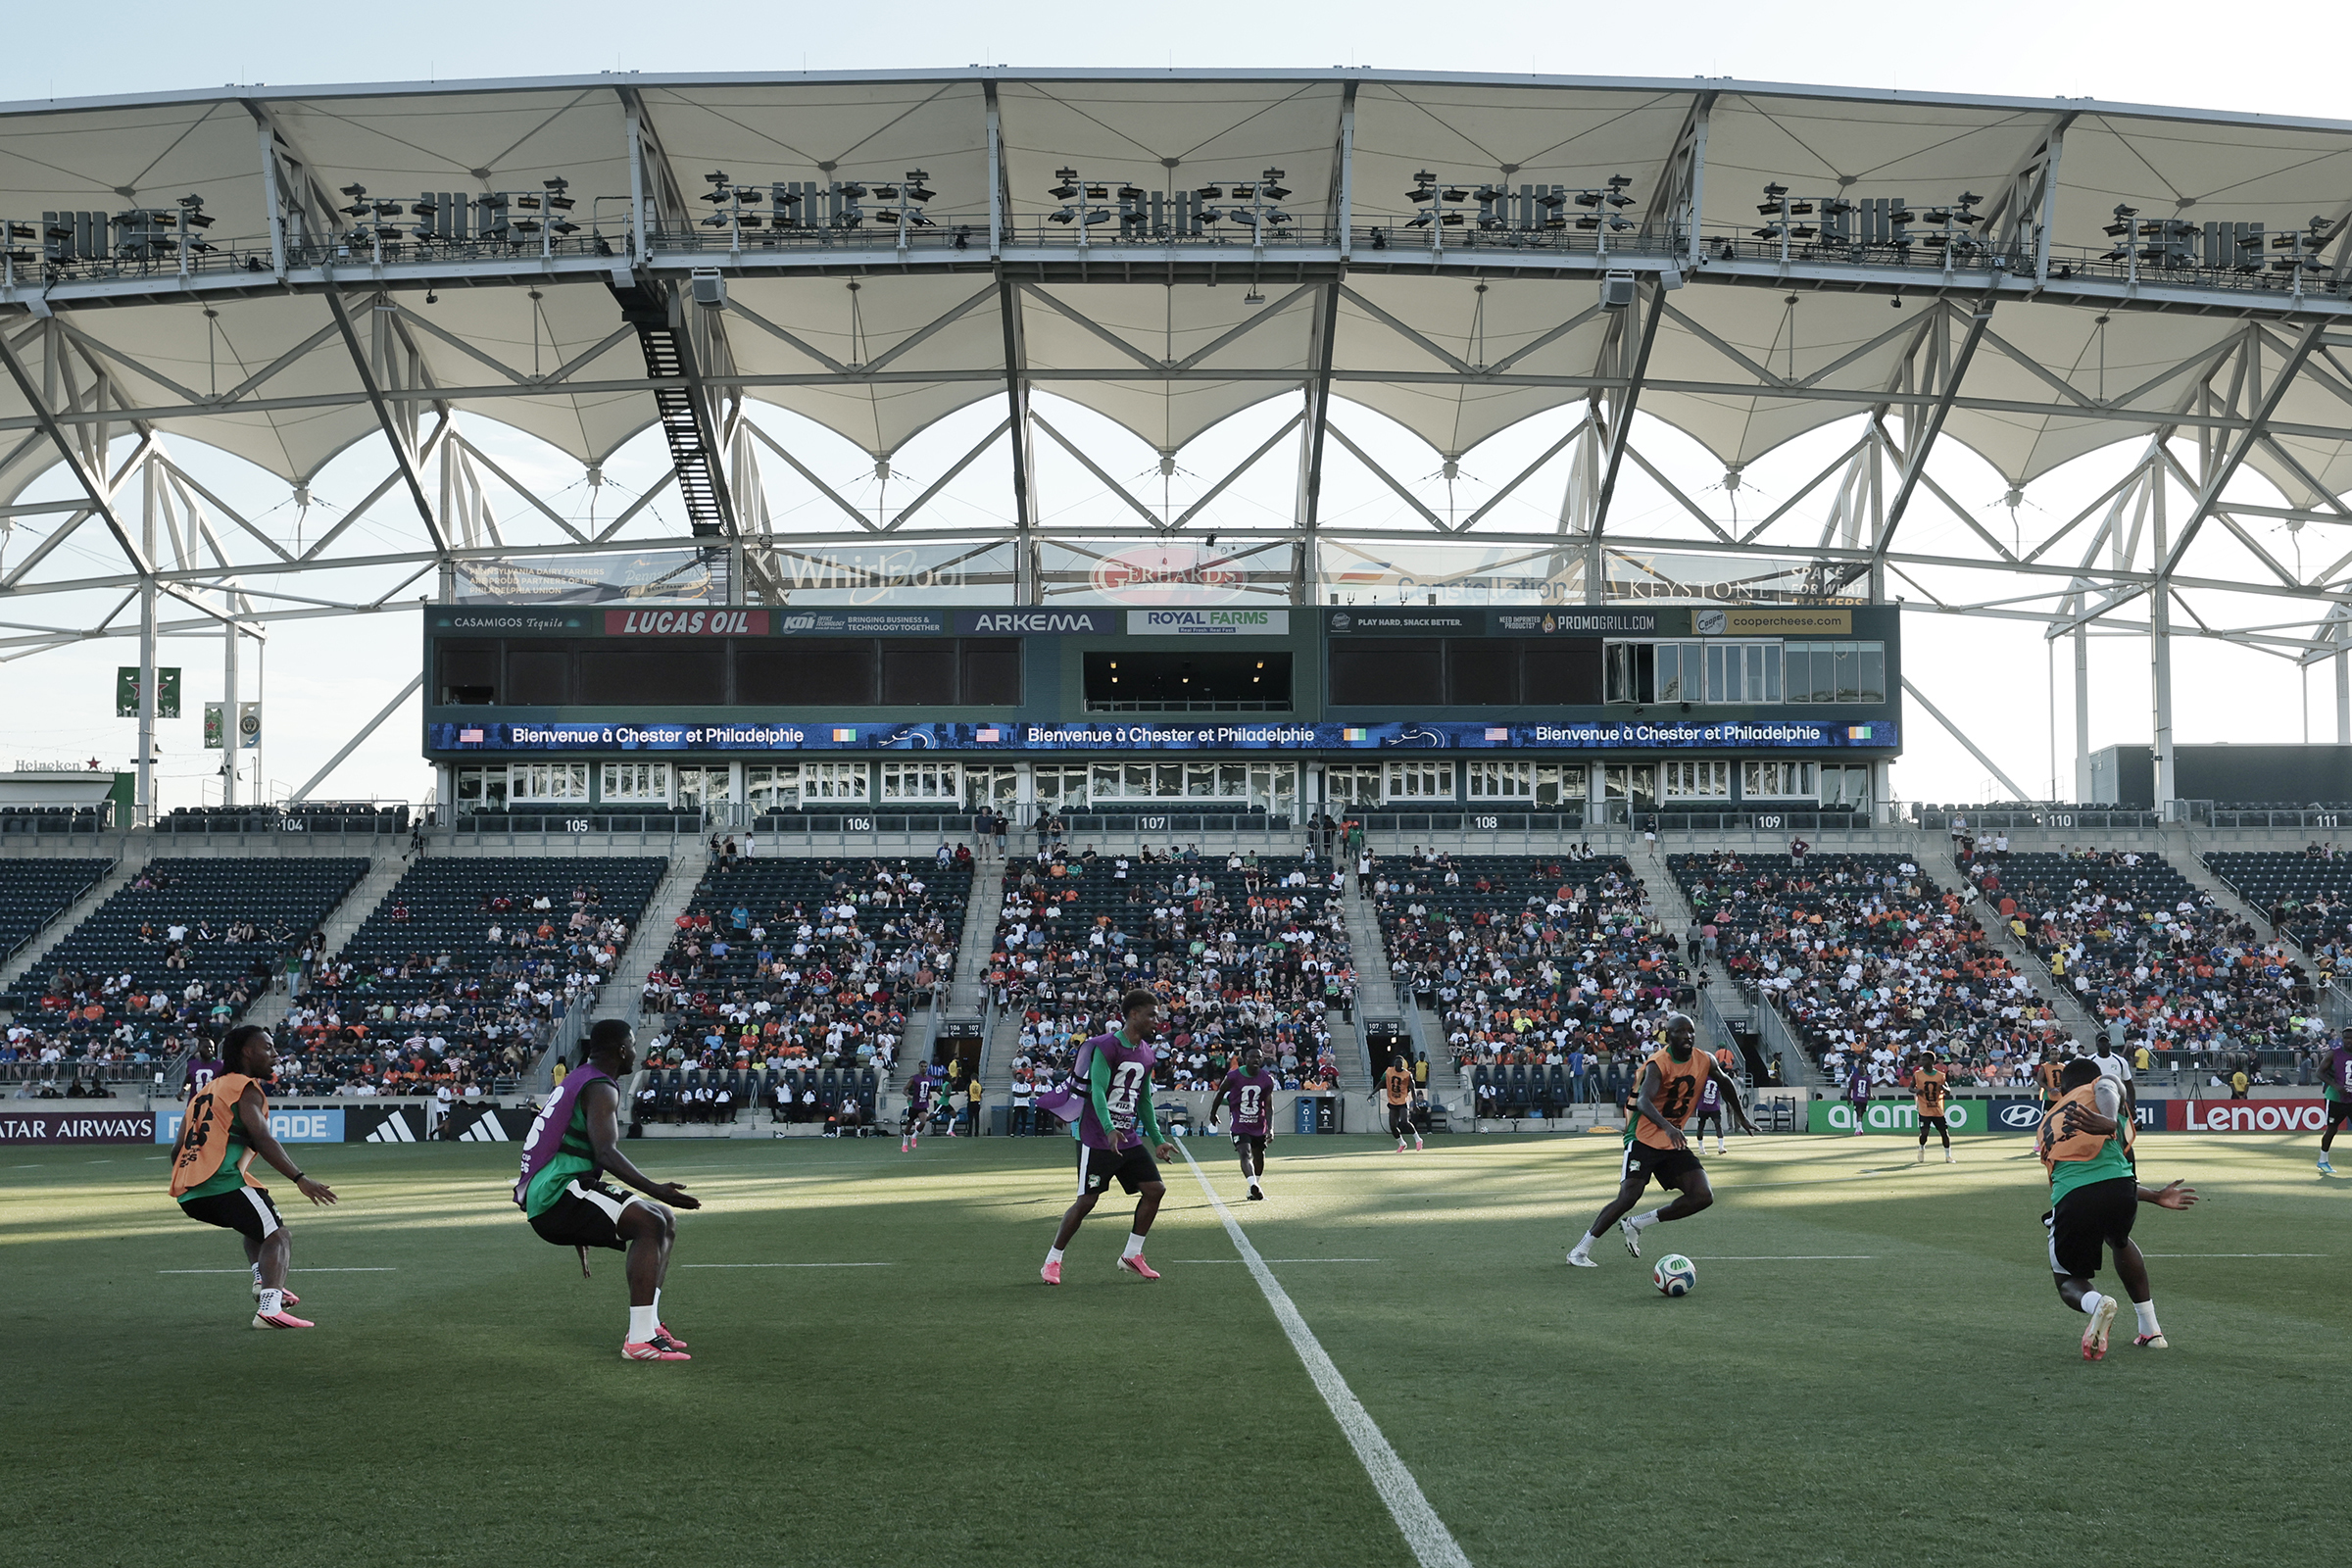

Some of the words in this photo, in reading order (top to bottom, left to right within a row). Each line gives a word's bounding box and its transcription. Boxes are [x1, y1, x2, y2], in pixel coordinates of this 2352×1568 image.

[787, 553, 966, 600] Whirlpool
[1790, 566, 1844, 580] SPACE
[1397, 575, 1567, 601] Constellation
[1629, 577, 1770, 601] KEYSTONE
[1790, 583, 1819, 595] FOR
[1823, 583, 1864, 595] WHAT
[454, 617, 522, 628] CASAMIGOS
[525, 617, 564, 631] Tequila
[623, 611, 707, 634] LUCAS
[710, 611, 750, 634] OIL
[974, 613, 1095, 631] ARKEMA
[1148, 612, 1205, 625] ROYAL
[1210, 612, 1268, 625] FARMS
[1379, 618, 1403, 627] HARD,
[1557, 615, 1654, 630] PROMOGRILL.COM
[1697, 613, 1724, 631] Cooper
[1733, 616, 1842, 628] coopercheese.com
[513, 728, 599, 743] Bienvenue
[604, 727, 612, 742] à
[615, 728, 683, 743] Chester
[686, 730, 703, 743] et
[706, 728, 805, 746] Philadelphie
[1027, 727, 1111, 742] Bienvenue
[1116, 726, 1125, 742] à
[1128, 727, 1195, 742] Chester
[1199, 729, 1214, 742] et
[1217, 727, 1315, 745] Philadelphie
[1536, 726, 1619, 741] Bienvenue
[1624, 725, 1633, 741] à
[1636, 726, 1701, 741] Chester
[1705, 728, 1721, 741] et
[1724, 725, 1821, 743] Philadelphie
[16, 760, 80, 771] Heineken
[280, 818, 303, 831] 104
[564, 819, 588, 832] 105
[848, 818, 870, 831] 106
[1141, 817, 1164, 830] 107
[1475, 816, 1497, 829] 108
[1758, 815, 1781, 828] 109
[2048, 814, 2072, 827] 110
[2316, 814, 2338, 827] 111
[1828, 1103, 1968, 1129] aamo
[2185, 1101, 2327, 1131] Lenovo
[56, 1119, 152, 1138] AIRWAYS
